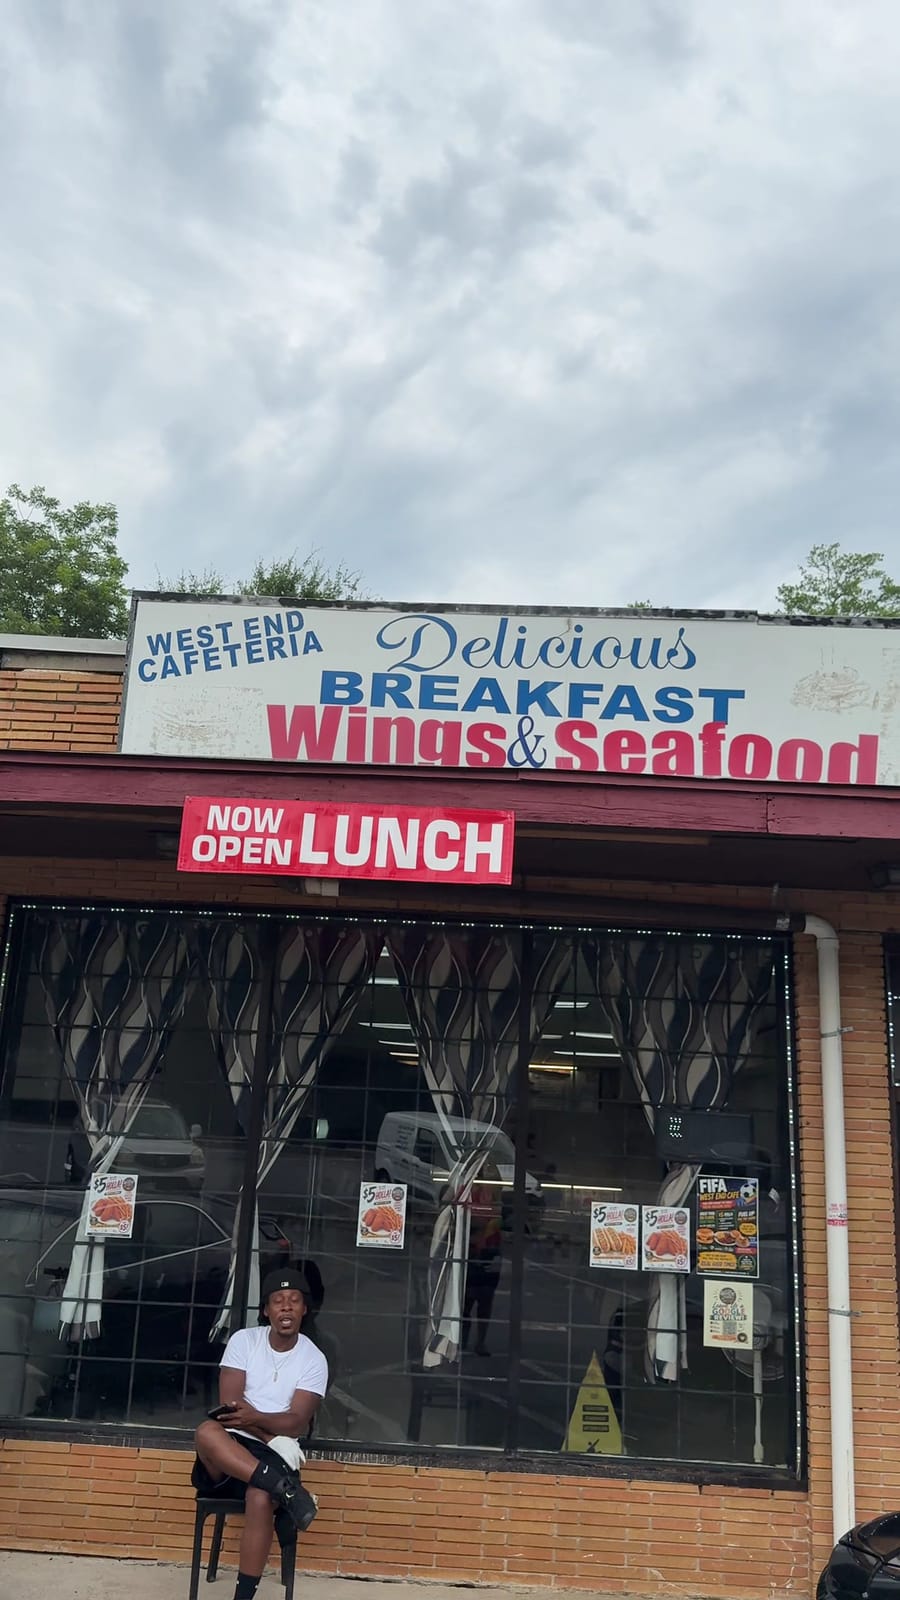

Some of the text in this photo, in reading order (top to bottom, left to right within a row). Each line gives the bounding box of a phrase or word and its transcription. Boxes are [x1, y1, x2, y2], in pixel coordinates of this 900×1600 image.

[146, 610, 305, 657] WEST END
[376, 614, 696, 672] Delicious
[137, 630, 323, 683] CAFETERIA
[319, 670, 746, 725] BREAKFAST
[267, 704, 879, 785] Wings & Seafood
[206, 805, 284, 834] NOW
[191, 835, 293, 866] OPEN
[299, 813, 505, 874] LUNCH
[94, 1177, 108, 1193] $5
[363, 1186, 377, 1203] $5
[700, 1178, 728, 1193] FIFA
[700, 1190, 740, 1201] WEST END CAFE
[593, 1206, 607, 1223] $5
[645, 1210, 659, 1227] $5
